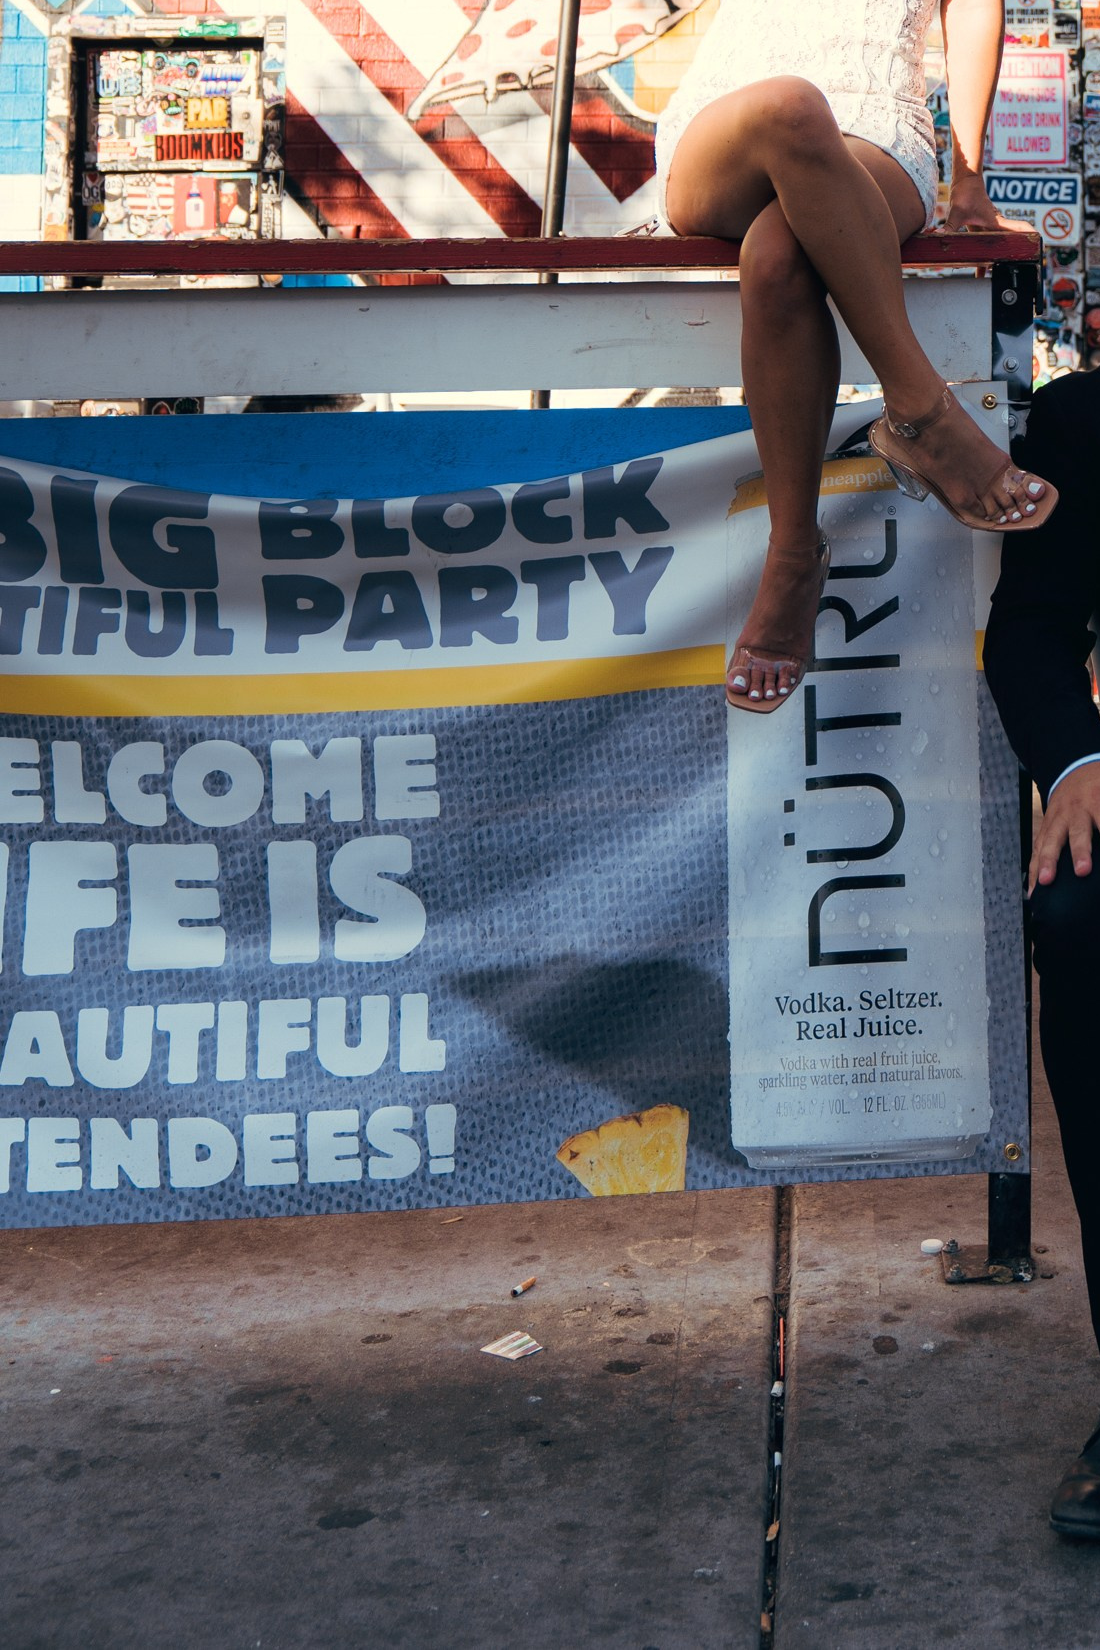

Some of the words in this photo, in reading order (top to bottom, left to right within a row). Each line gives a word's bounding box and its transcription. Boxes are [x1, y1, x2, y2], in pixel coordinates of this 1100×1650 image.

[1001, 56, 1061, 78] TTENTION
[1015, 87, 1057, 103] OUTSIDE
[996, 112, 1019, 127] FOOD
[1021, 112, 1033, 127] OR
[1035, 112, 1061, 127] DRINK
[1006, 136, 1050, 153] ALLOWED
[988, 179, 1075, 202] NOTICE
[820, 467, 894, 492] neapple
[260, 456, 671, 562] BLOCK
[264, 545, 676, 655] PARTY
[0, 839, 228, 978] FE
[266, 833, 429, 966] IS
[774, 991, 853, 1017] Vodka.
[858, 987, 943, 1012] Seltzer.
[0, 991, 448, 1089] AUTIFUL
[796, 1017, 848, 1042] Real
[853, 1014, 923, 1039] Juice.
[779, 1054, 817, 1072] Vodka
[820, 1053, 849, 1070] with
[852, 1051, 877, 1068] real
[880, 1050, 909, 1067] fruit
[910, 1049, 941, 1068] juice,
[758, 1071, 807, 1093] sparkling
[809, 1070, 849, 1088] water,
[851, 1067, 876, 1085] and
[880, 1065, 925, 1083] natural
[927, 1064, 963, 1082] flavors.
[863, 1097, 874, 1114] 12
[876, 1096, 892, 1113] FL.
[893, 1095, 910, 1112] OZ.
